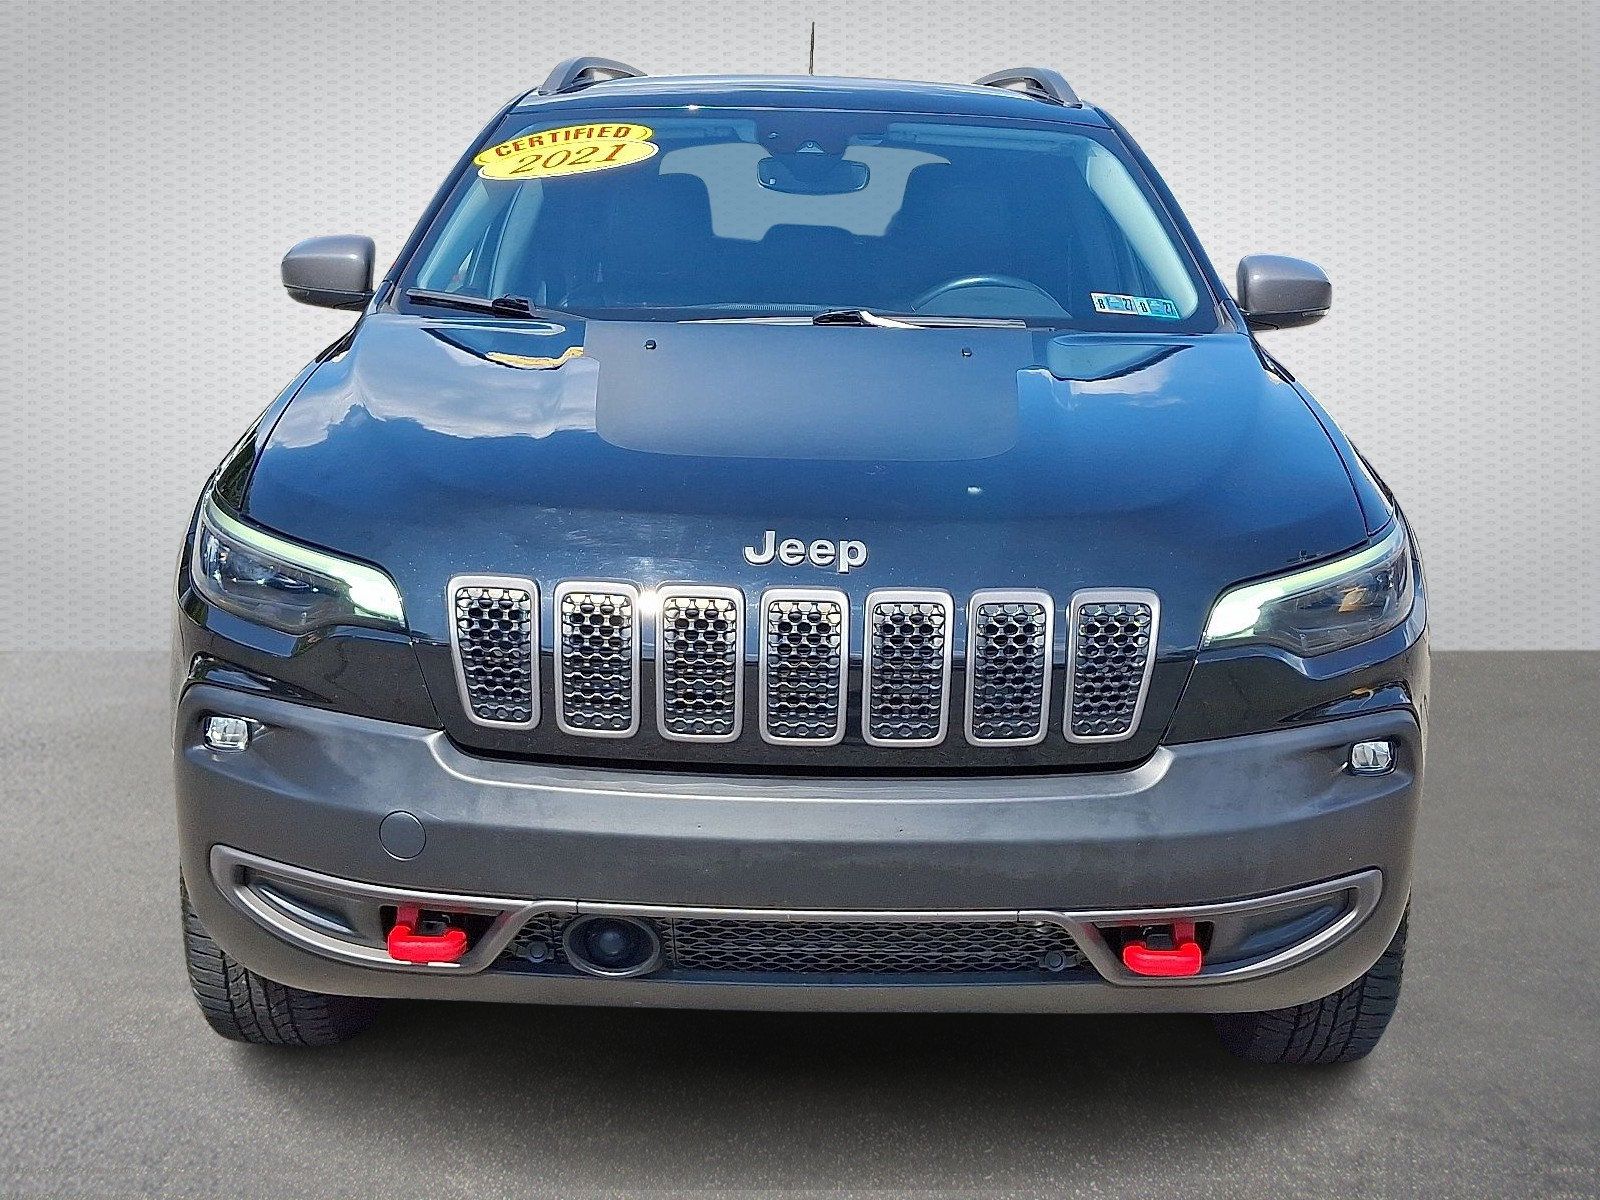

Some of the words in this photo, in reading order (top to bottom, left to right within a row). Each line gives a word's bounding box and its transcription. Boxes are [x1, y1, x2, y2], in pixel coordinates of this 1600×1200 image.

[495, 126, 632, 157] CERTIFIED
[508, 143, 628, 175] 2021
[743, 530, 868, 574] Jeep
